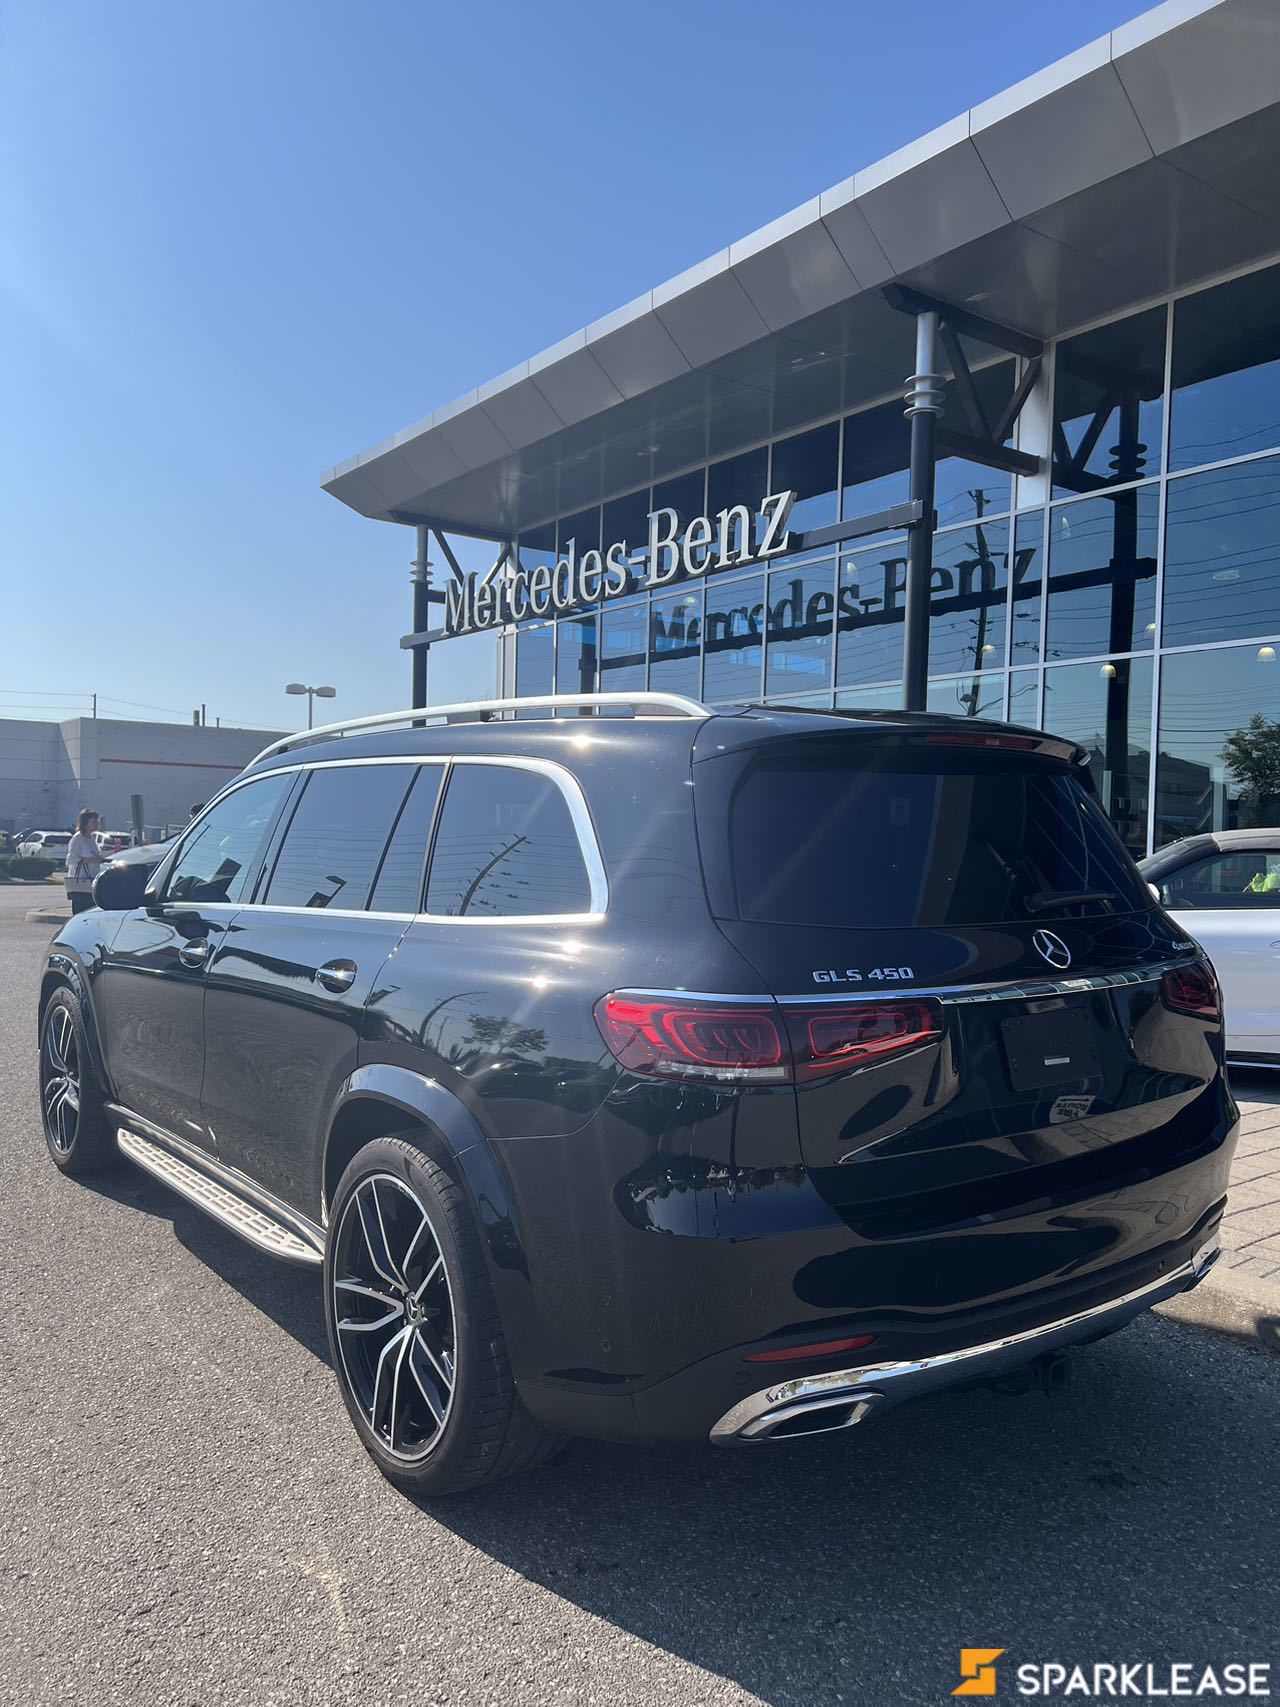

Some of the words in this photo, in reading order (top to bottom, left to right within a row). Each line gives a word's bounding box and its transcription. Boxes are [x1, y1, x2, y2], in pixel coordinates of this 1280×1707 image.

[442, 489, 797, 637] Mercedes-Benz
[812, 969, 863, 983] GLS
[867, 967, 915, 980] 450
